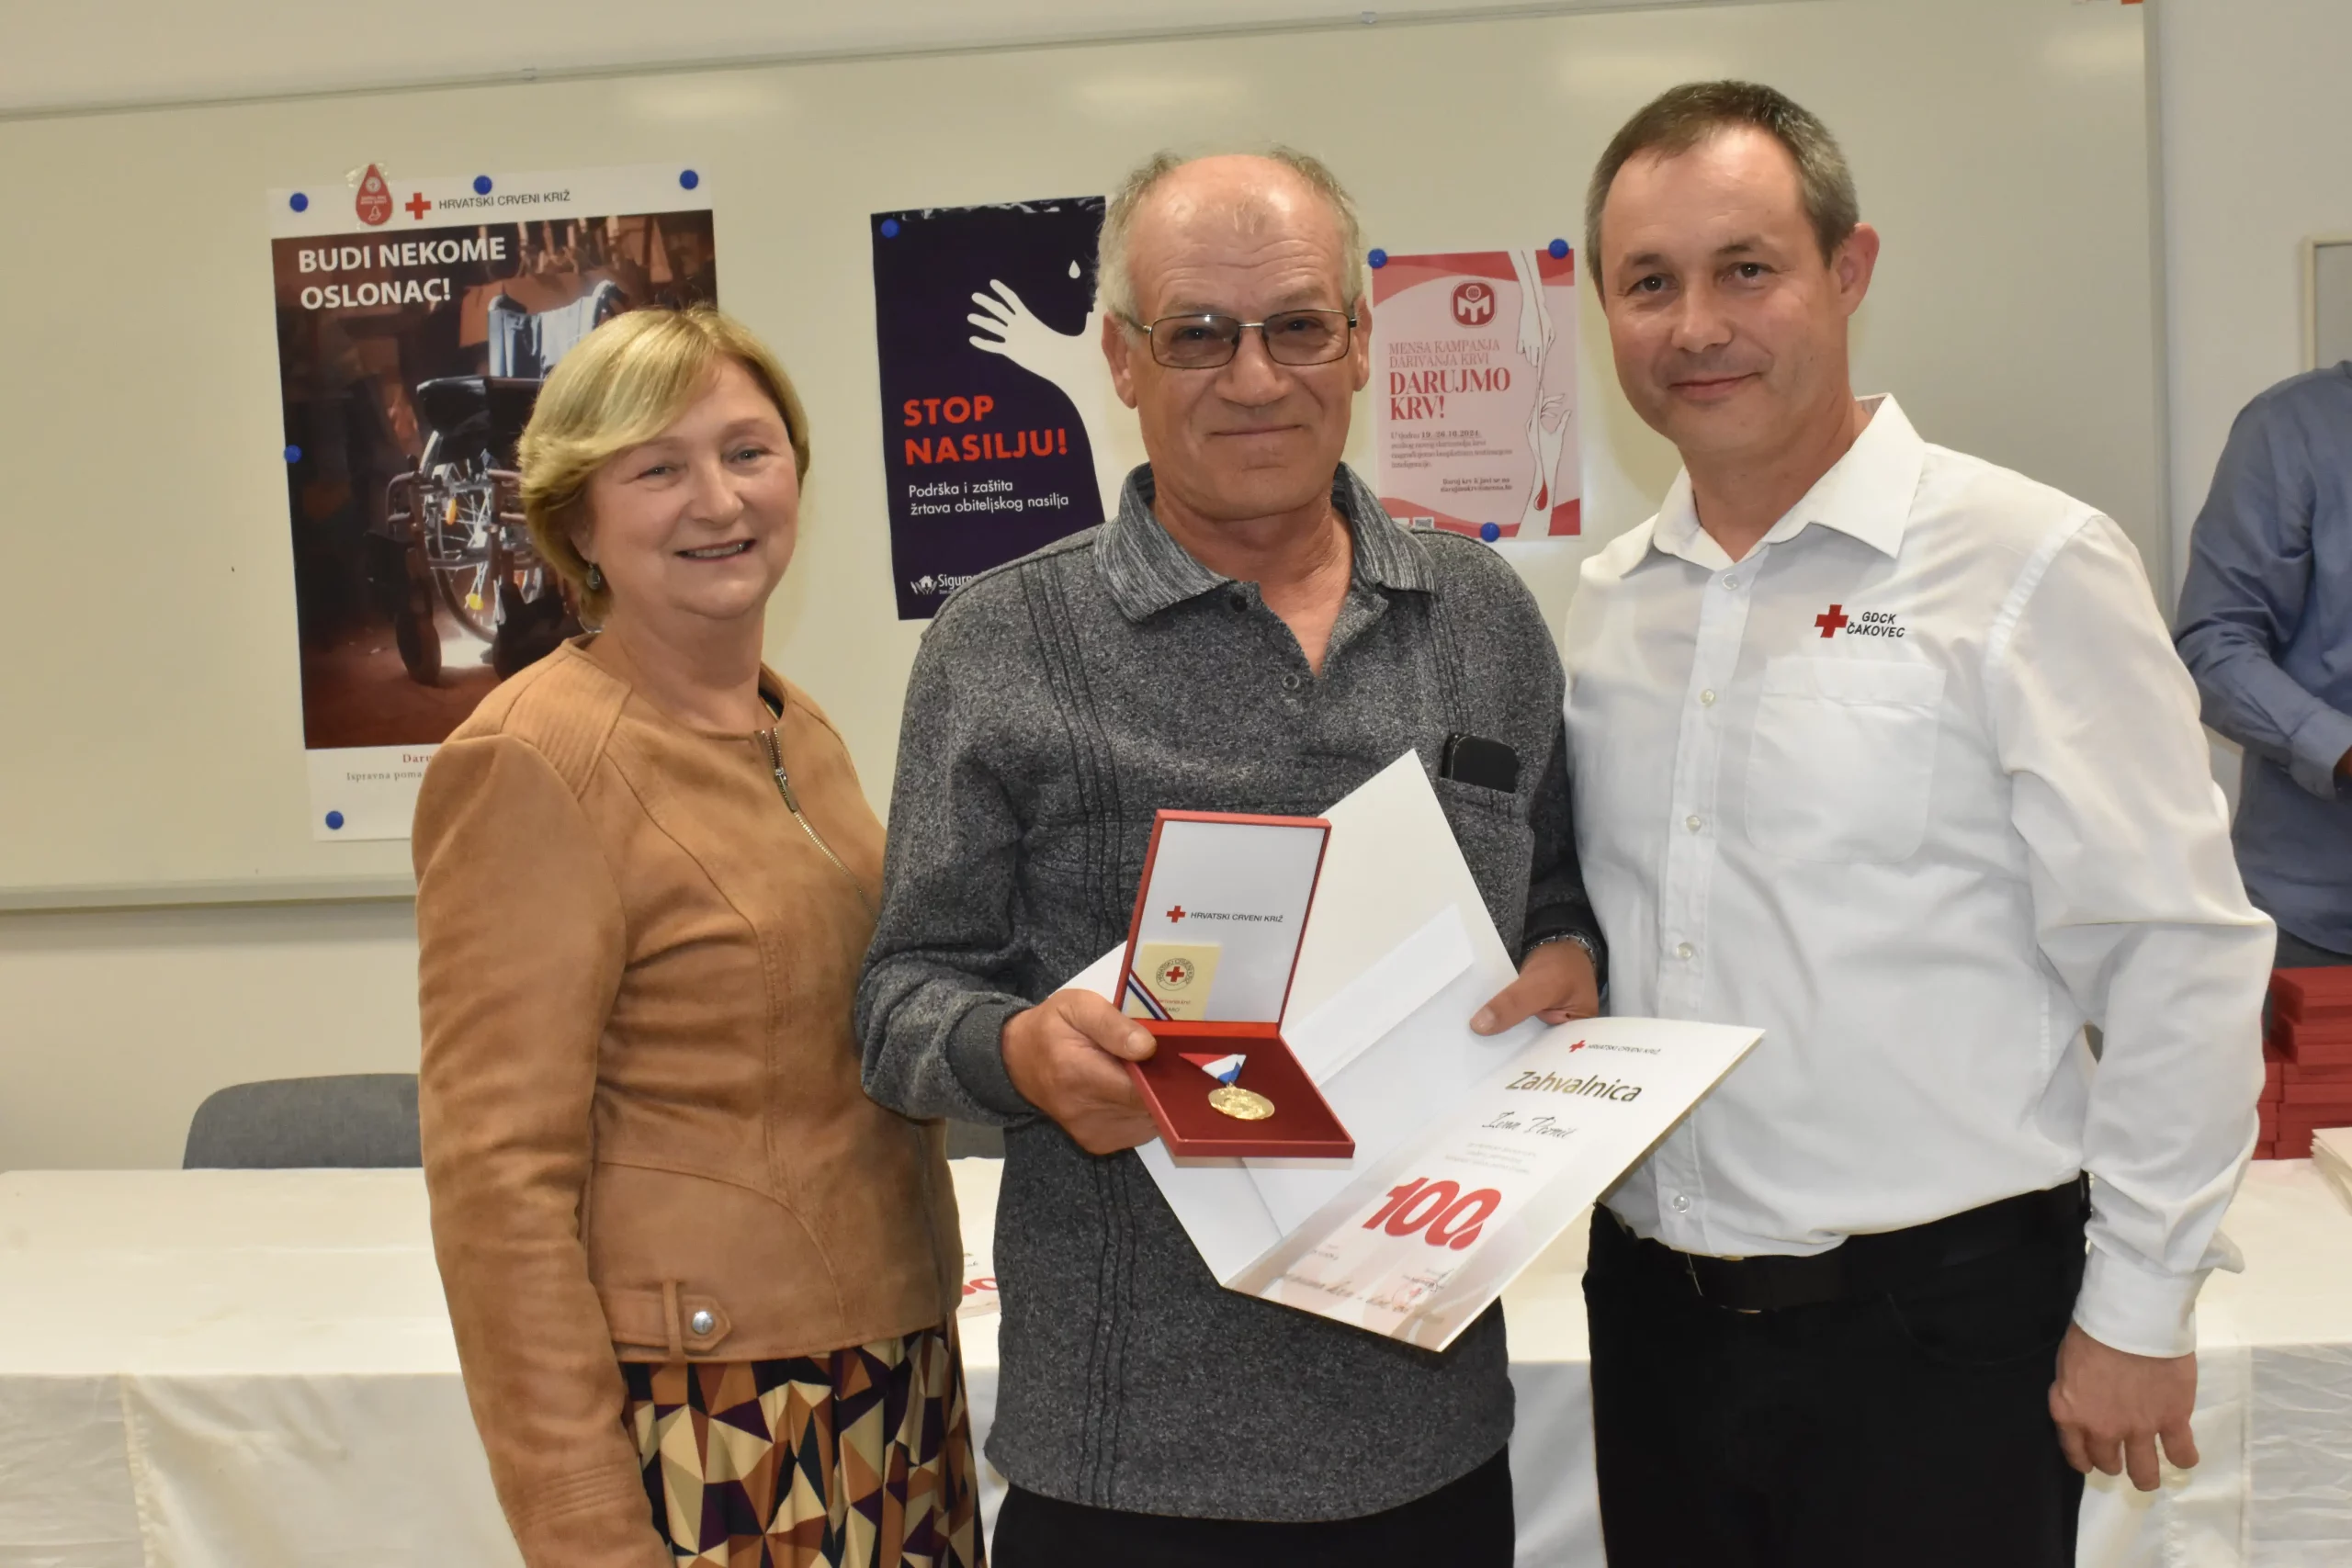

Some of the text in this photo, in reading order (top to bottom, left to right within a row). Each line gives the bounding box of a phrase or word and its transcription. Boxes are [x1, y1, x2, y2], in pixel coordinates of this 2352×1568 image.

[438, 189, 571, 209] HRVATSKI CRVENI KRIŽ
[298, 237, 506, 274] BUDI NEKOME
[300, 277, 452, 310] OSLONAC!
[1389, 339, 1500, 355] MENSA KAMPANJA
[1389, 353, 1489, 368] DARIVANJA KRVI
[1389, 367, 1511, 396] DARUJMO
[903, 394, 994, 427] STOP
[1390, 395, 1445, 420] KRV!
[904, 428, 1068, 466] NASILJU!
[909, 479, 1013, 498] Podrška i zaštita
[910, 492, 1069, 515] žrtava obiteljskog nasilja
[1861, 612, 1896, 625] GDCK
[1847, 622, 1905, 637] ČAKOVEC
[347, 772, 390, 783] Ispravna
[1191, 911, 1283, 923] HRVATSKI CRVENI KRIŽ
[1505, 1071, 1643, 1102] Zahvalnica
